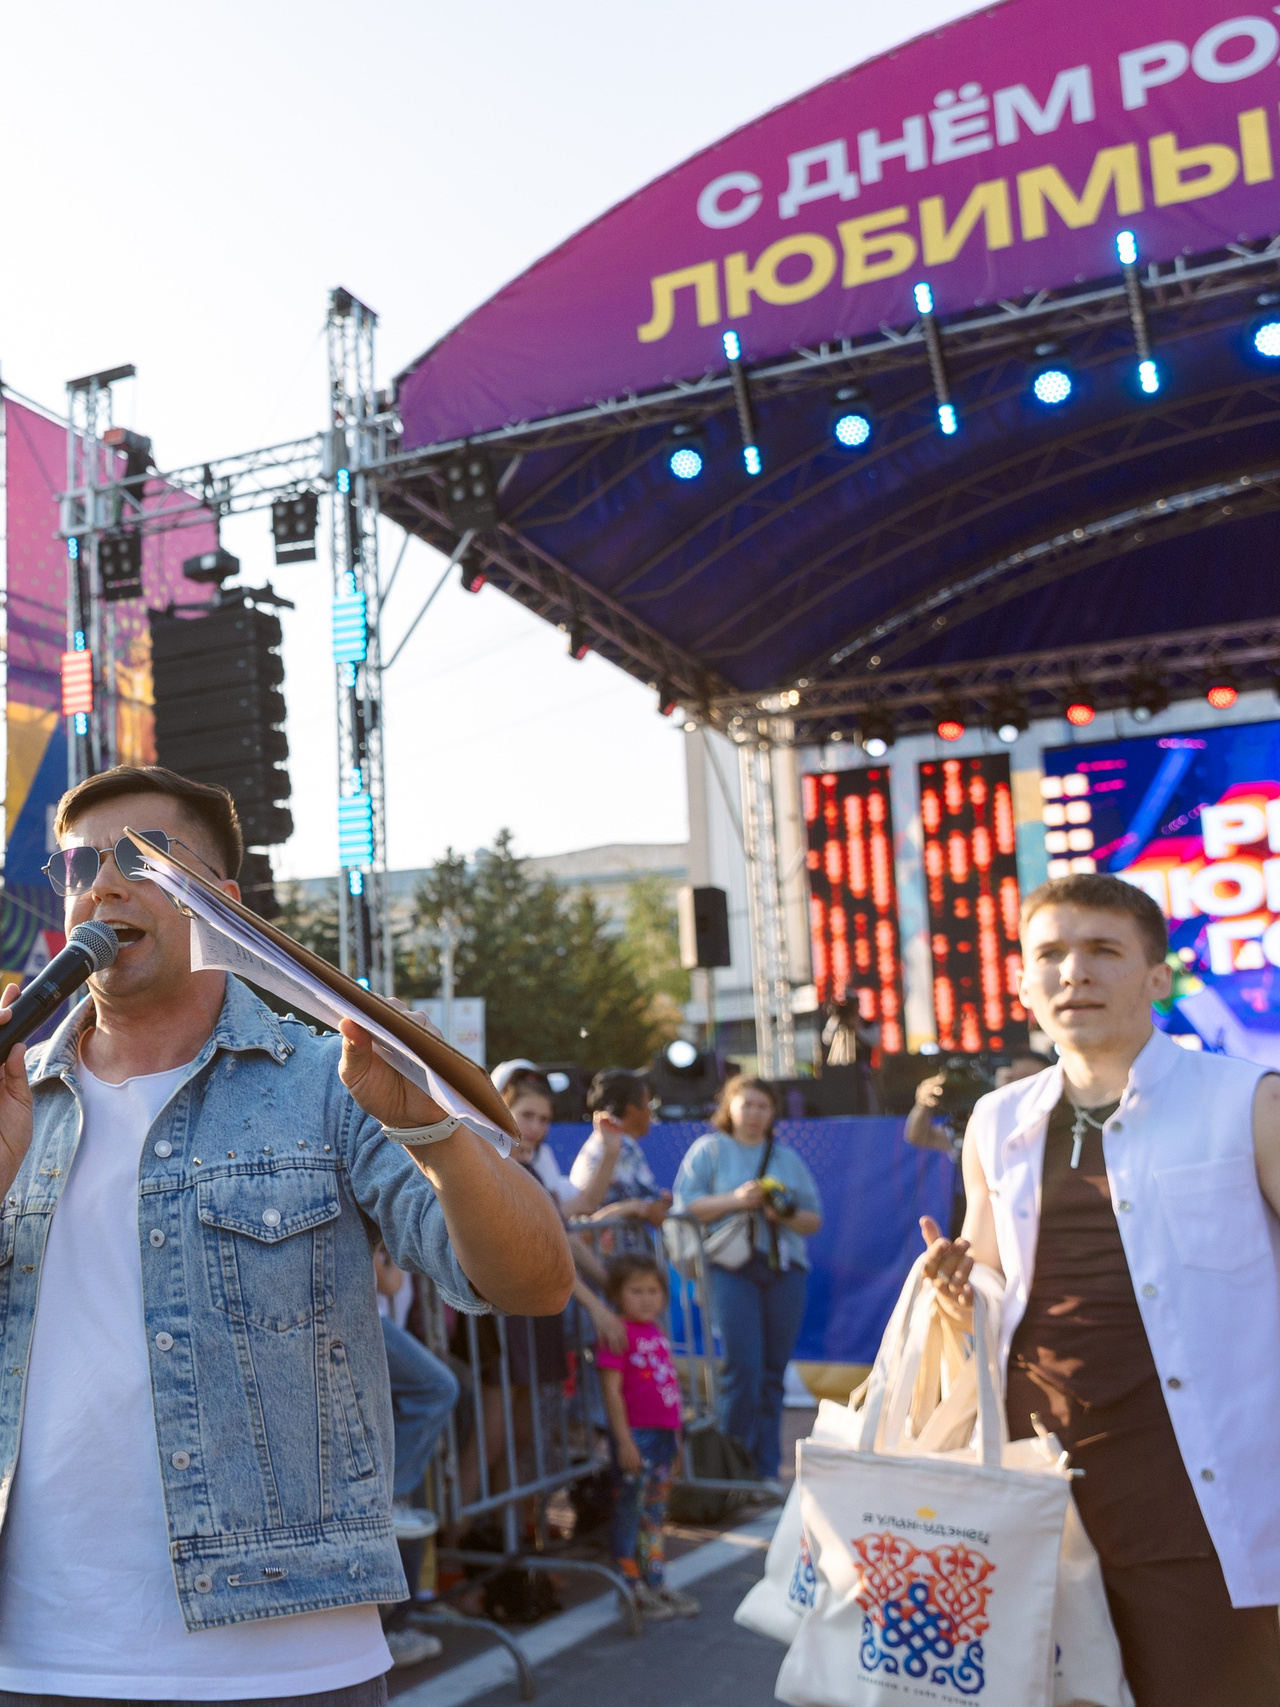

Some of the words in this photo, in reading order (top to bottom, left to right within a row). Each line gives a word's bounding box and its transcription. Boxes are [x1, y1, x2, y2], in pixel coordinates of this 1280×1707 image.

[696, 170, 762, 229] С
[778, 64, 1096, 220] ДНЁМ
[1118, 4, 1280, 111] РО
[637, 101, 1280, 343] ЛЮБИМЫ
[1201, 800, 1280, 859] Р
[1206, 918, 1280, 976] Г
